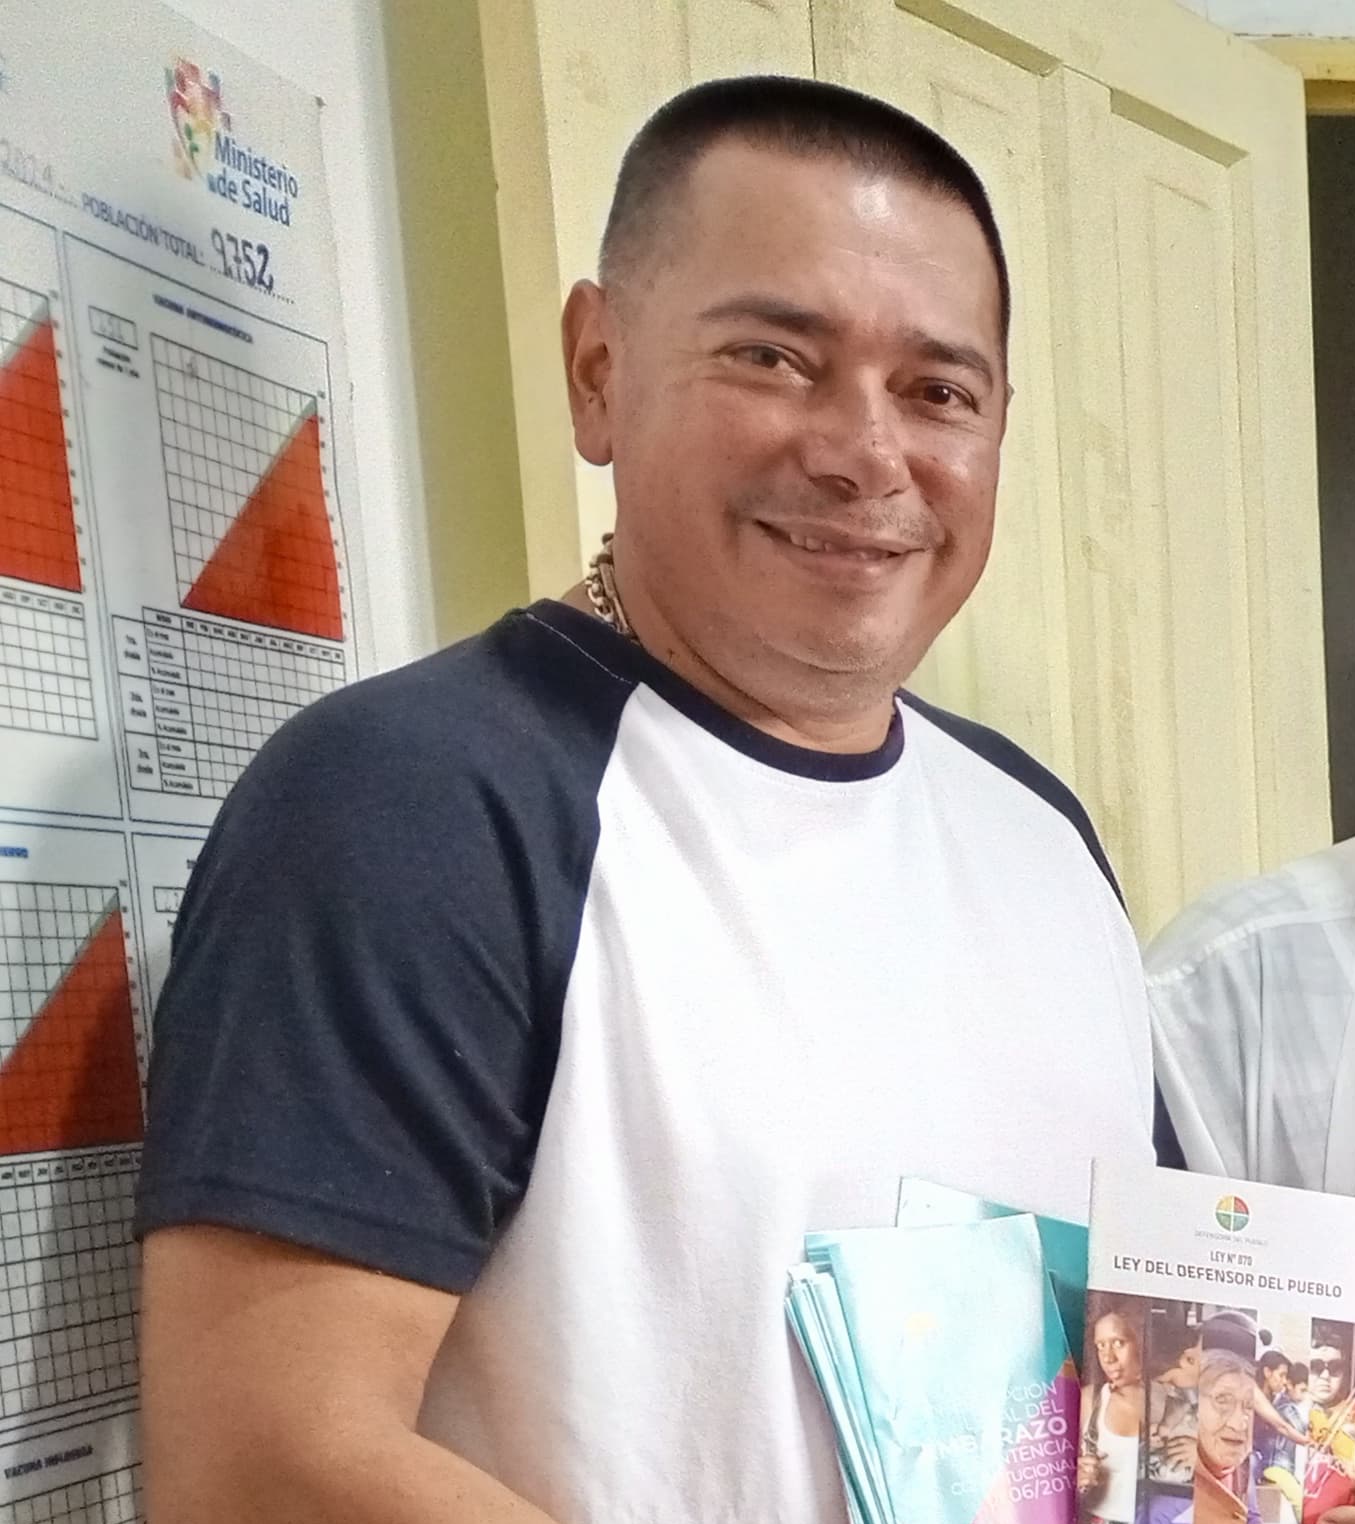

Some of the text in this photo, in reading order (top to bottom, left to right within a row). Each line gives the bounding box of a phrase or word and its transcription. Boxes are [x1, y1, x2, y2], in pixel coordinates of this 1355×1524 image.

[214, 132, 298, 199] Ministerio
[217, 172, 291, 227] de Salud
[1113, 1255, 1343, 1298] LEY DEL DEFENSOR DEL PUEBLO
[1210, 1251, 1226, 1263] LEY
[1026, 1399, 1065, 1418] DEL
